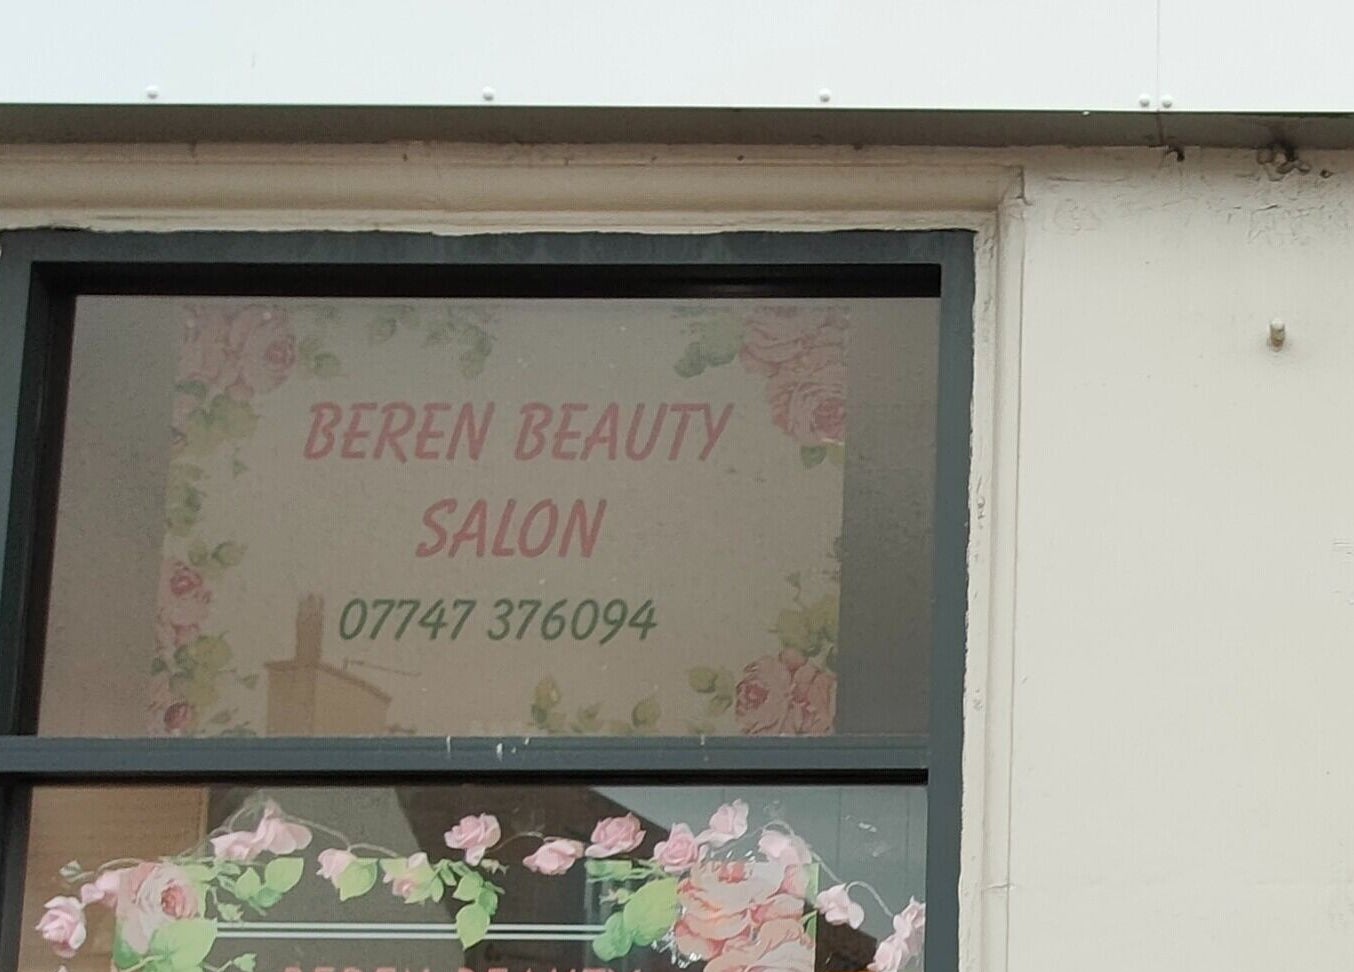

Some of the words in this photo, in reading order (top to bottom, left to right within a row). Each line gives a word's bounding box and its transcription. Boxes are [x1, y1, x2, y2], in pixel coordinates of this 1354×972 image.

[303, 402, 496, 464] BEREN
[513, 402, 735, 461] BEAUTY
[415, 498, 608, 558] SALON
[339, 598, 478, 641] 07747
[487, 598, 658, 645] 376094
